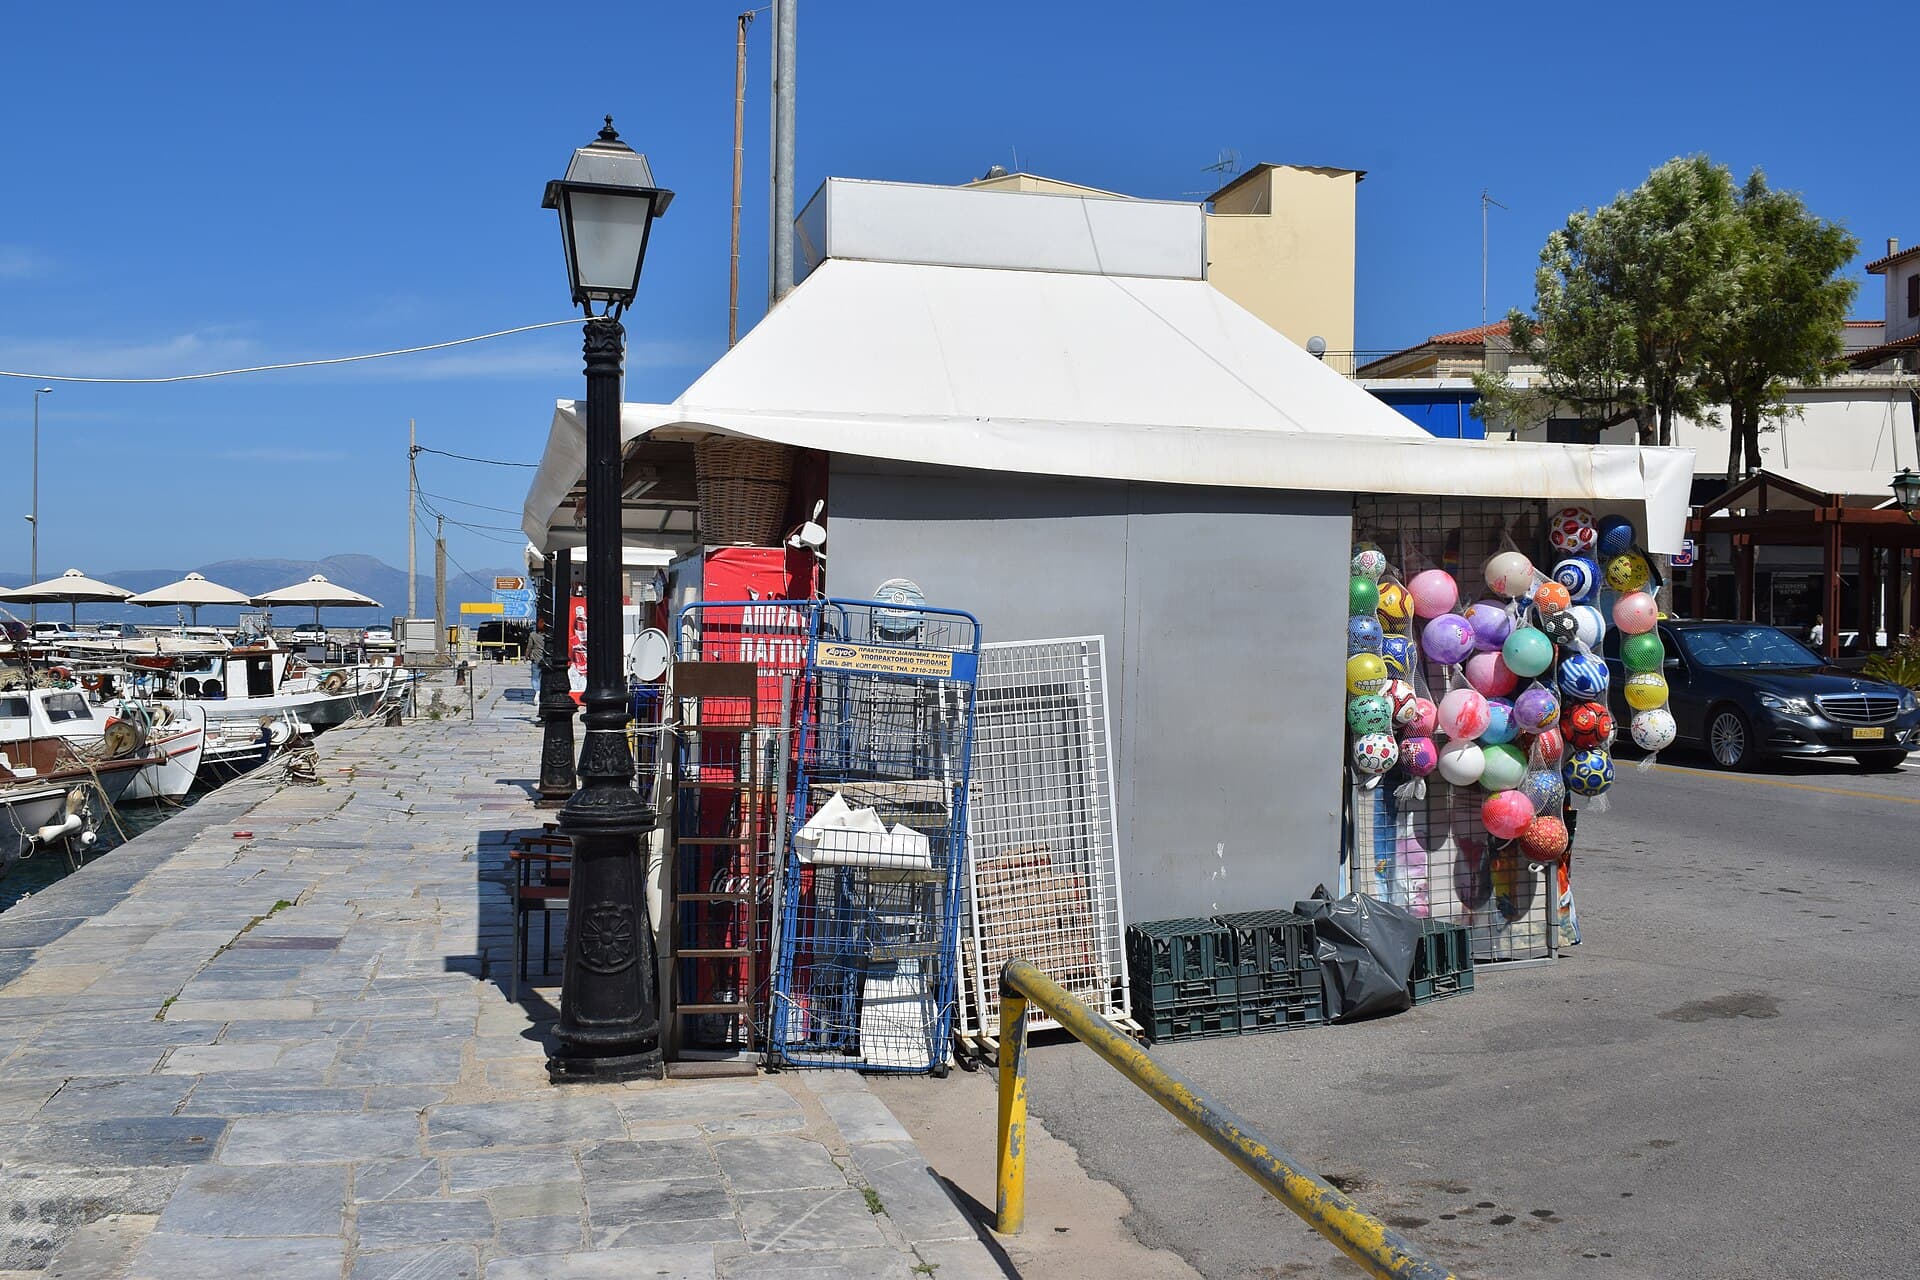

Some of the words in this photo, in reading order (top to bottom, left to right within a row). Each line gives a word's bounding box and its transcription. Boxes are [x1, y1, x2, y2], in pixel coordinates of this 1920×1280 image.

[858, 647, 897, 655] ΠΡΑΚΤΟΡΕΙΟ
[897, 650, 930, 658] ΔΙΑΝΟΜΗΣ
[860, 654, 914, 664] ΥΠΟΠΡΑΚΤΟΡΕΙΟ
[916, 659, 947, 667] ΤΡΙΠΟΛΗΣ
